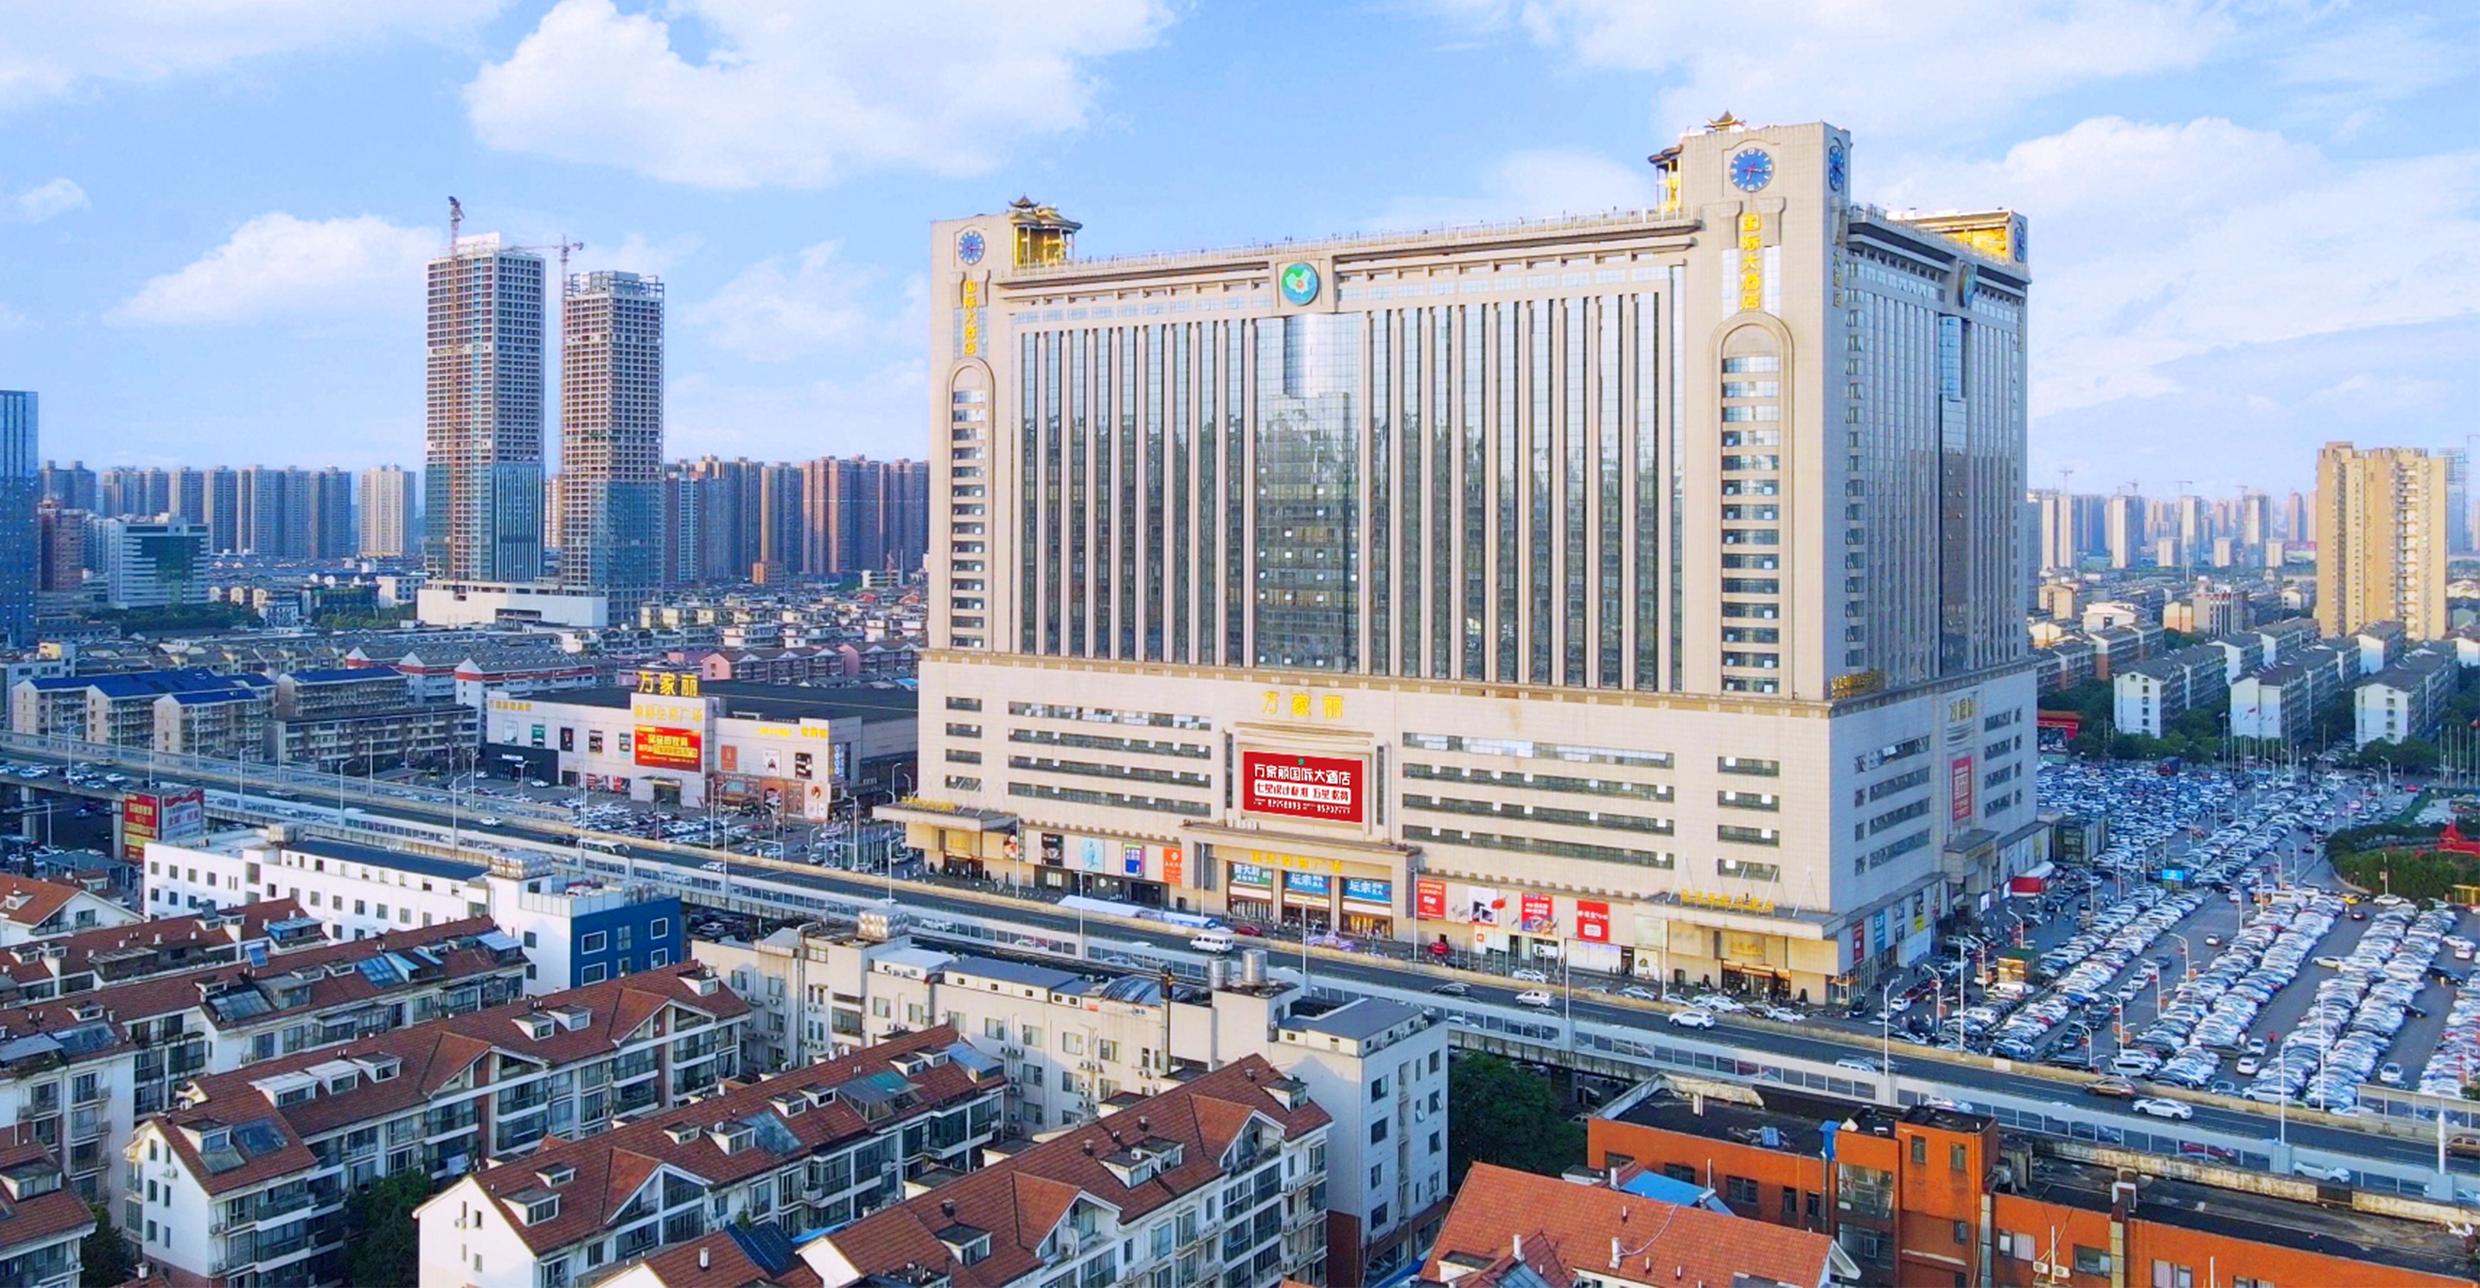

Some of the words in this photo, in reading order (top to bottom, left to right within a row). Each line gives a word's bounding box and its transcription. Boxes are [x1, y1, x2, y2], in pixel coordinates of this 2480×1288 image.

[1740, 213, 1761, 310] 国际大酒店
[637, 671, 698, 697] 万家丽
[1264, 691, 1344, 720] 万家丽
[1254, 764, 1351, 785] 万家丽国际大酒店
